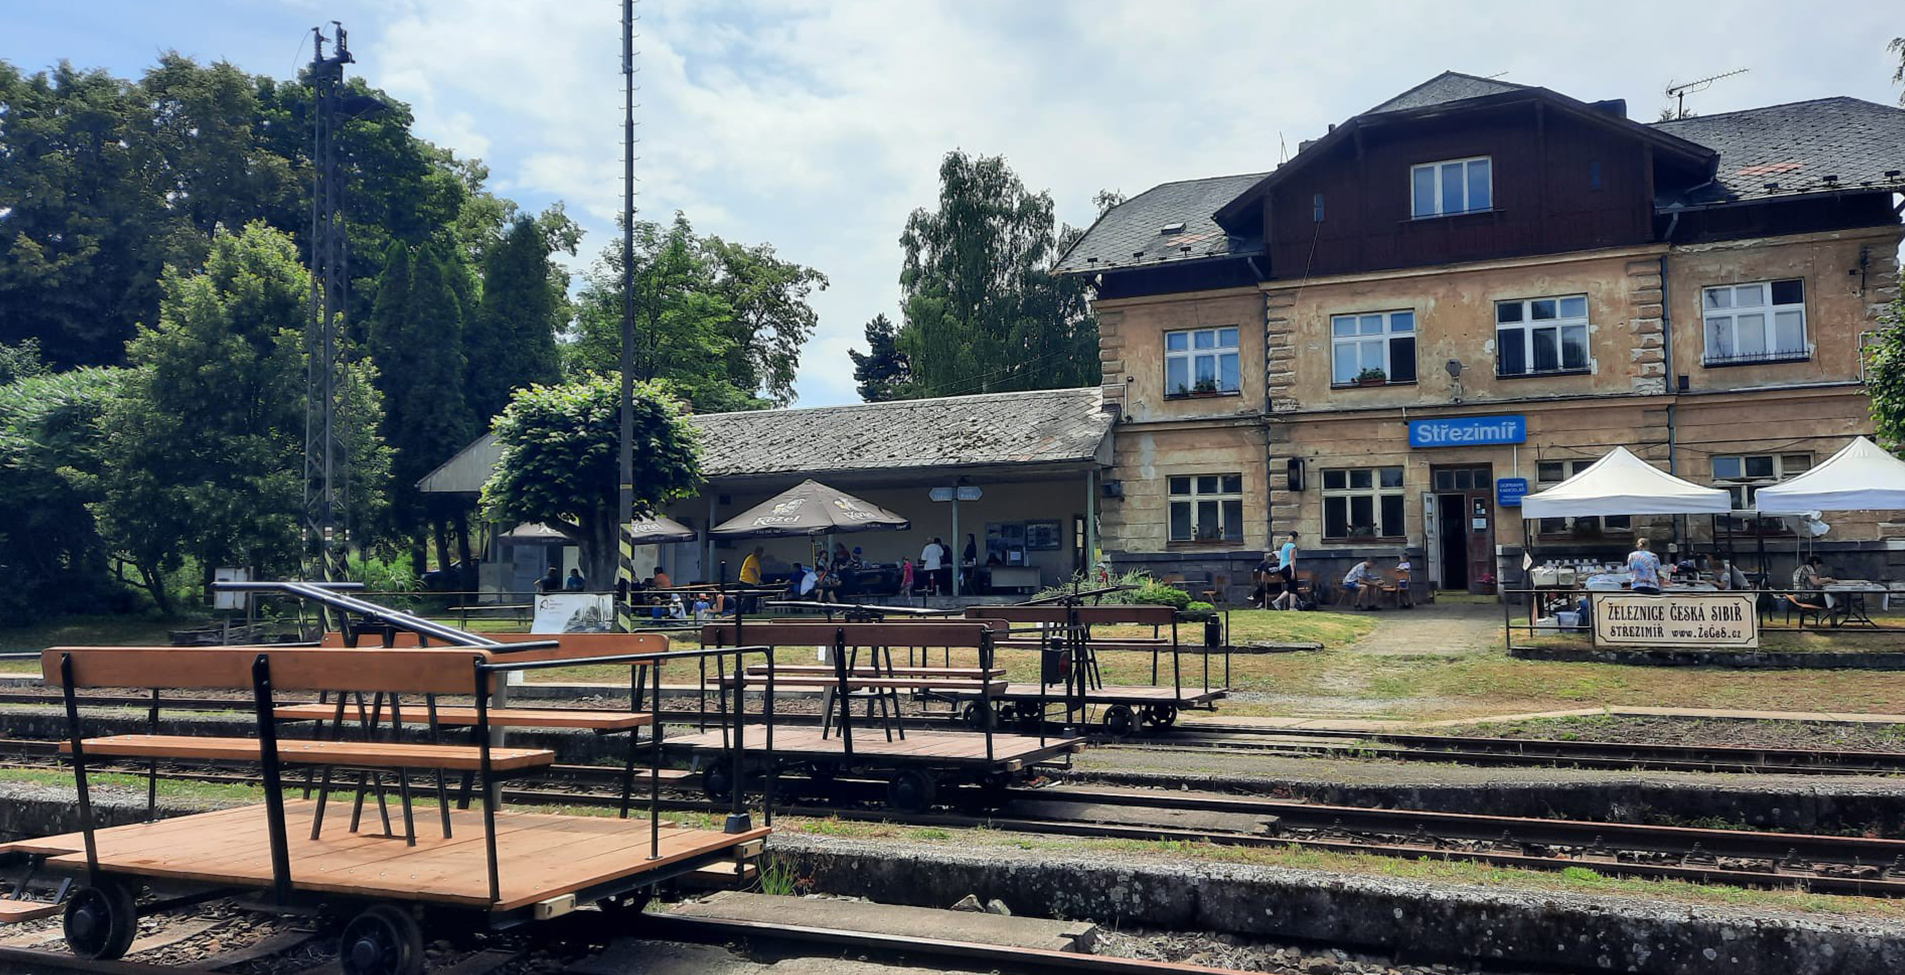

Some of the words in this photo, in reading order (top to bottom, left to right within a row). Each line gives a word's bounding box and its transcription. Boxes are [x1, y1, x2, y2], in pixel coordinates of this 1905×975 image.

[1417, 421, 1517, 443] Střezimíř
[753, 515, 801, 526] Kozel
[1608, 602, 1665, 621] ŽELEZNICE
[1670, 602, 1706, 621] ČESKÁ
[1711, 602, 1743, 621] SIBIŘ
[1610, 623, 1665, 638] STŘEZIMÍŘ
[1671, 624, 1742, 638] www.ŽeČeS.cz
